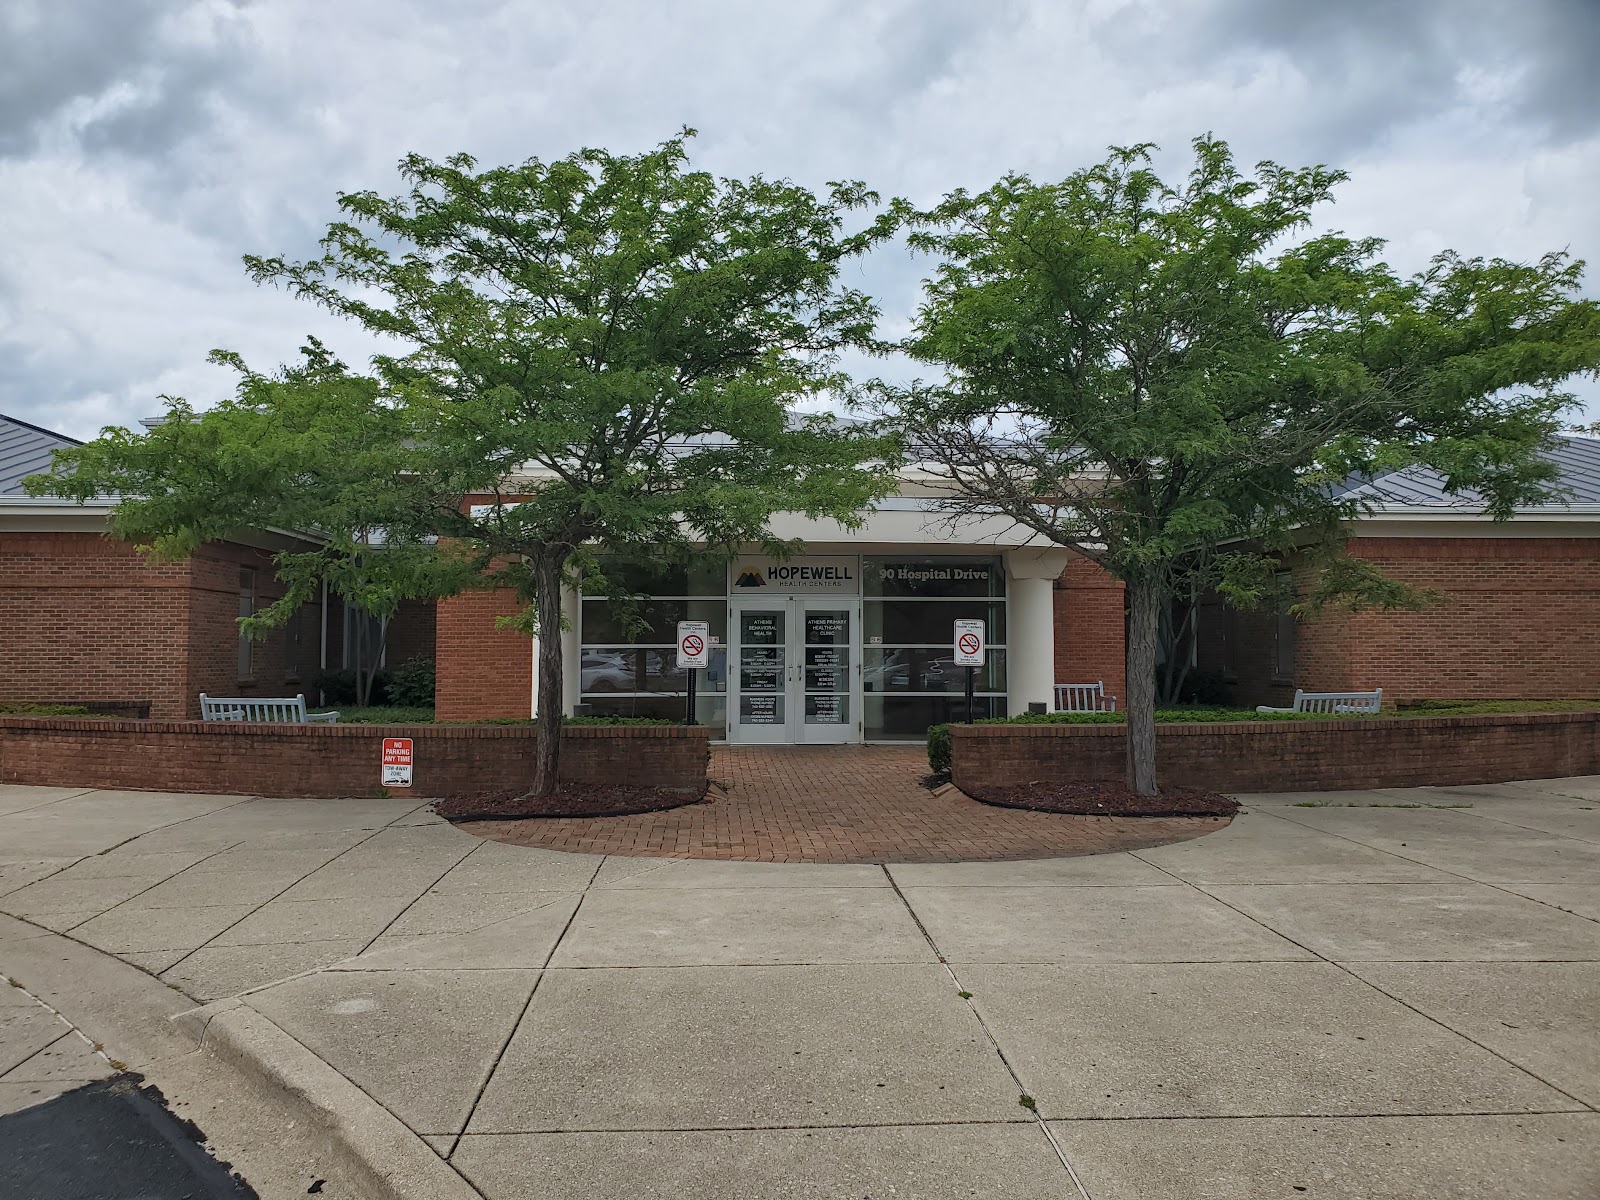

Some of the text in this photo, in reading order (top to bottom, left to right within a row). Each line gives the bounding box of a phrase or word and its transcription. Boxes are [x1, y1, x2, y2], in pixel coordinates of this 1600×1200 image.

[768, 566, 853, 580] HOPEWELL
[880, 568, 989, 582] 90 Hospital Drive
